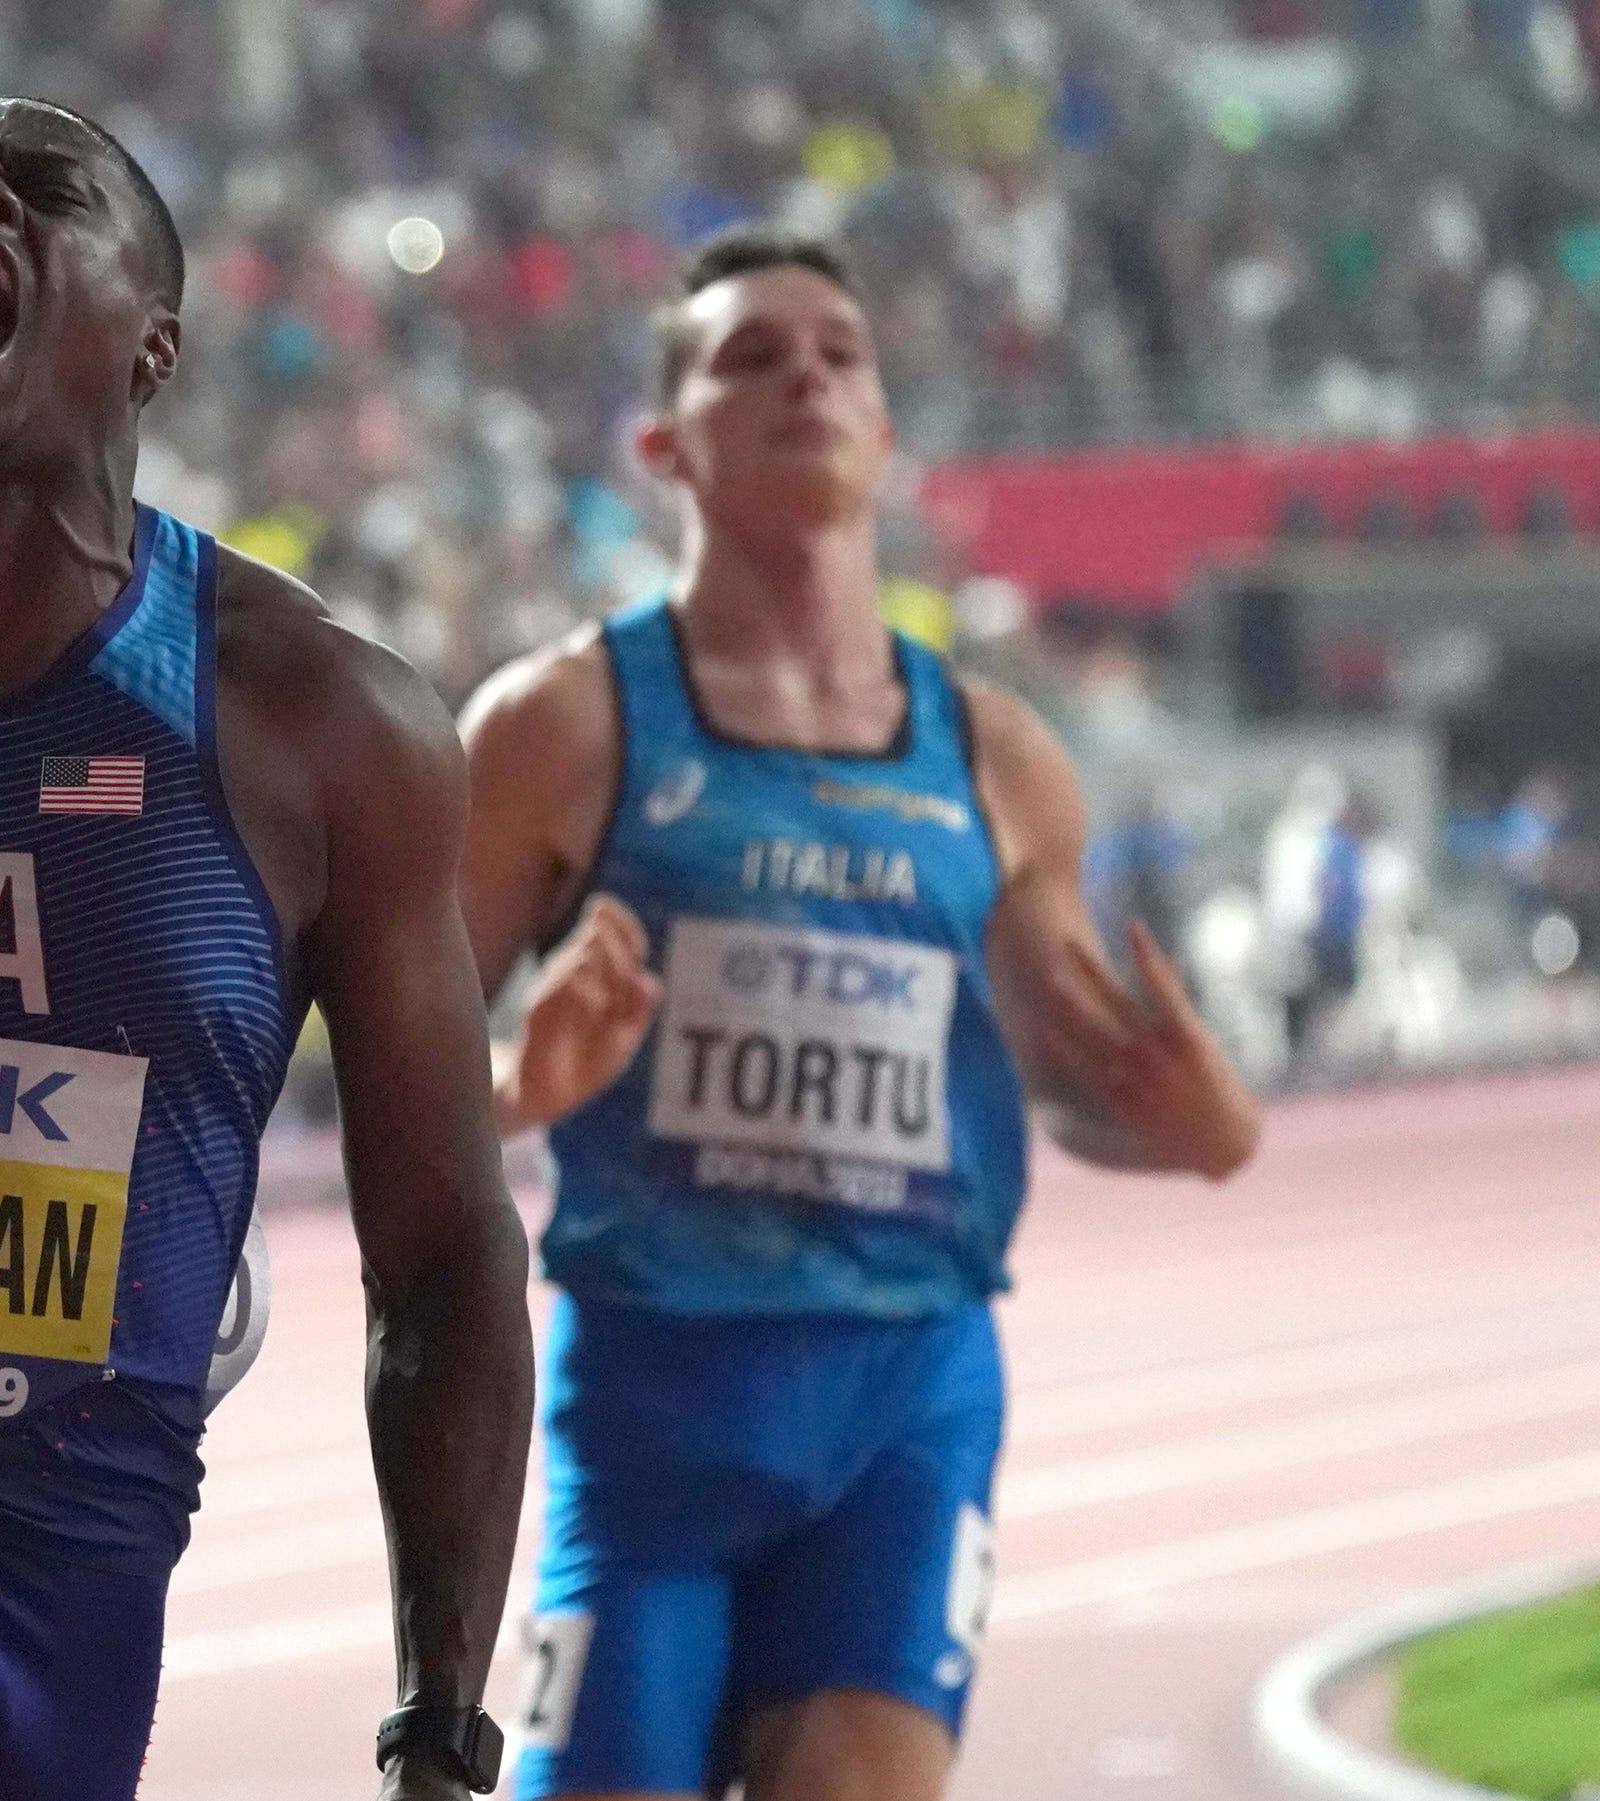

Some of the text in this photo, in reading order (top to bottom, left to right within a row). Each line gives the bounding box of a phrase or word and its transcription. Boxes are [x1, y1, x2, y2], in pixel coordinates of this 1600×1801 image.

[740, 838, 917, 901] ITALIA
[776, 944, 922, 1008] TDK
[682, 1026, 931, 1137] TORTU
